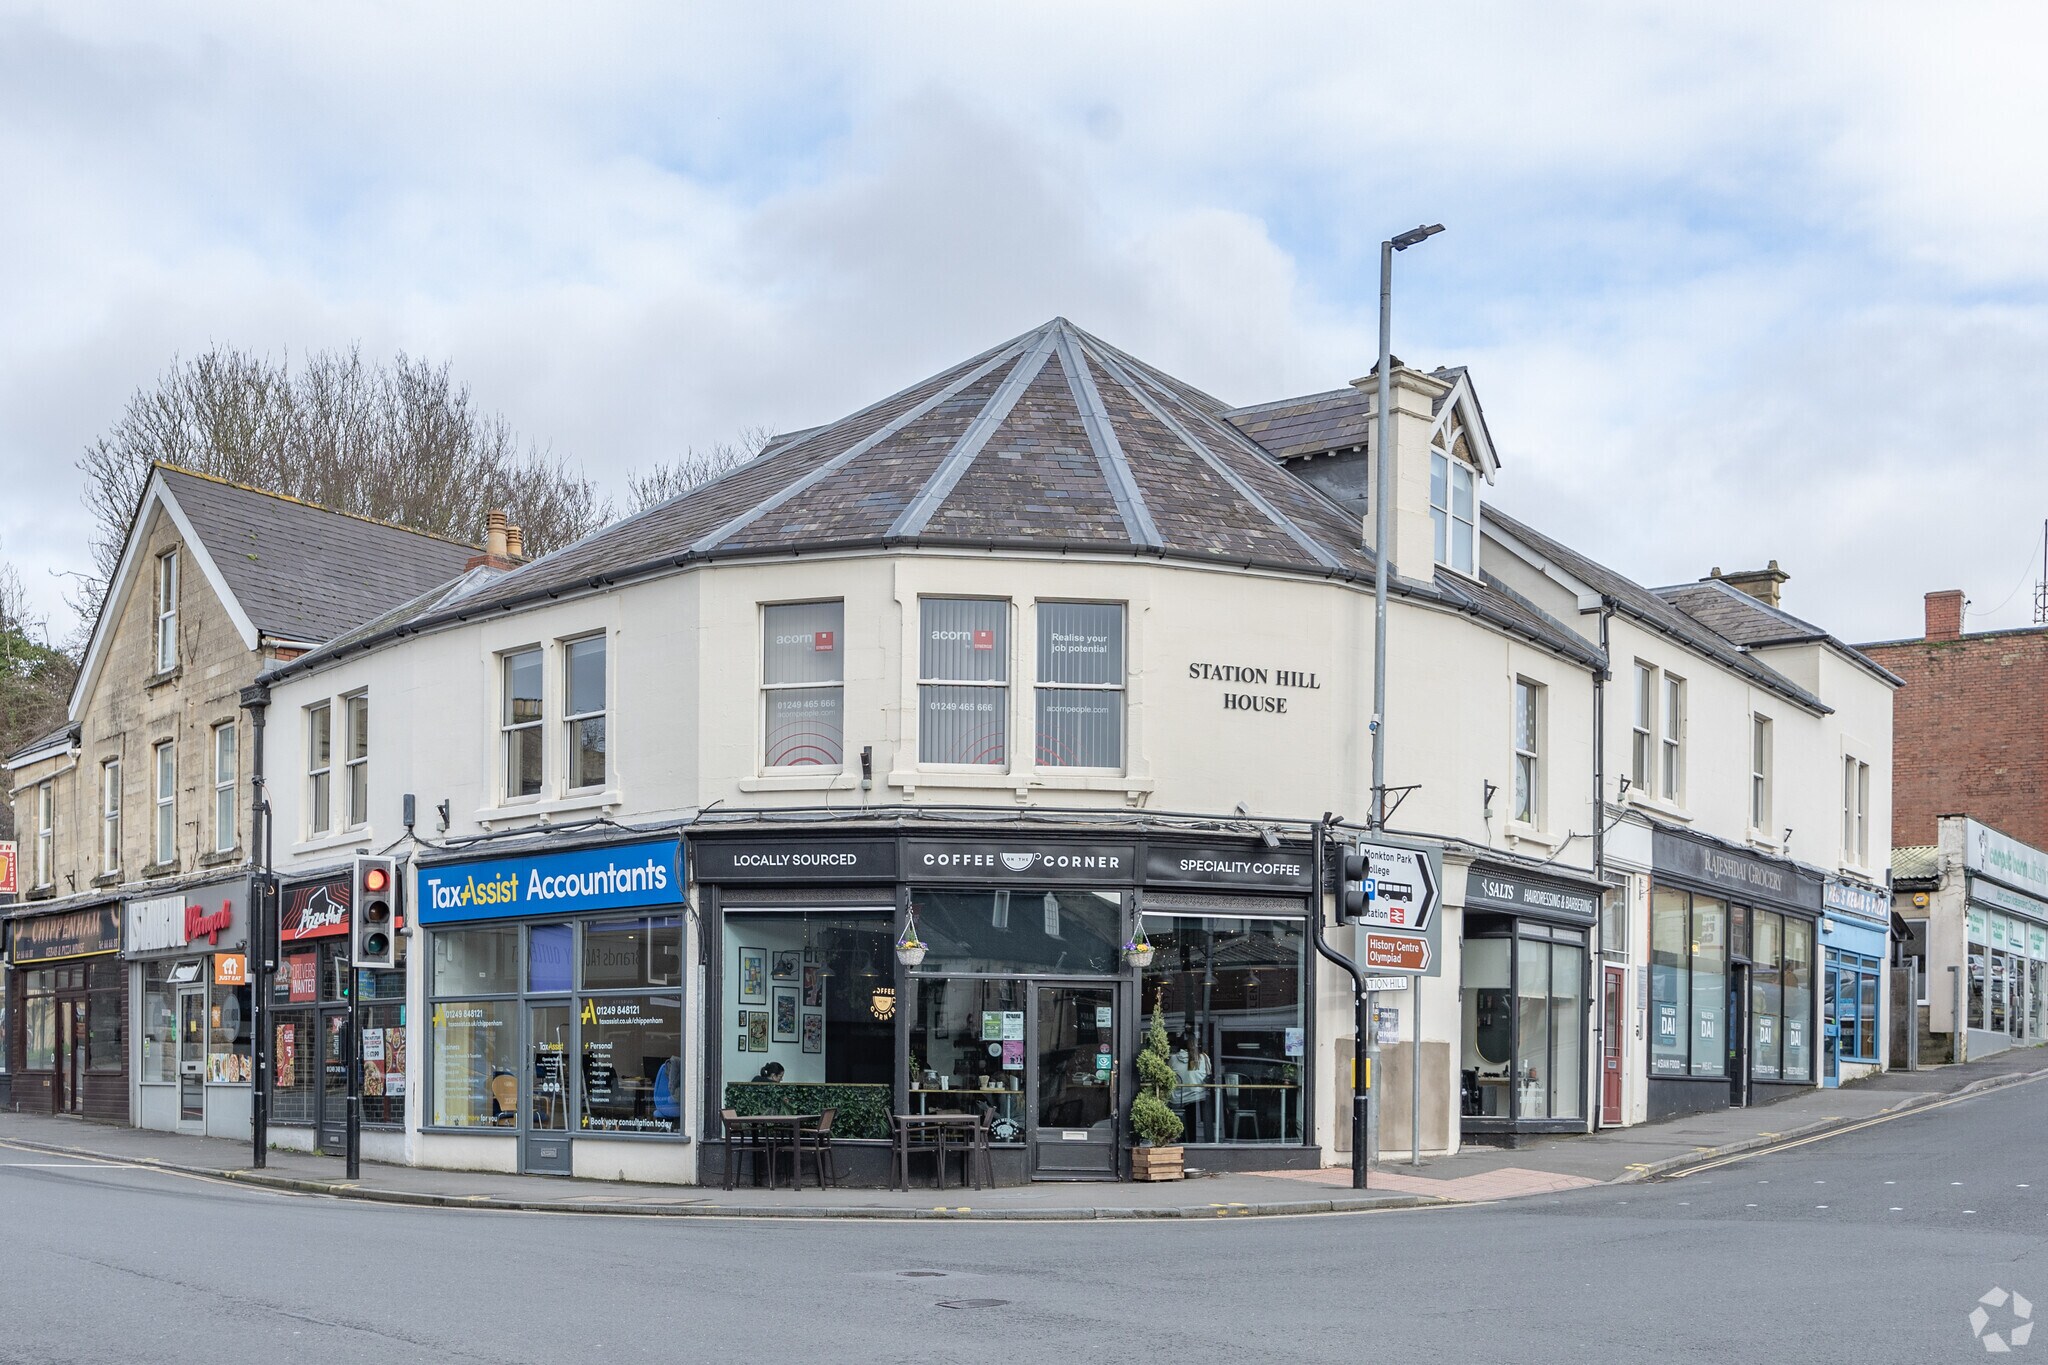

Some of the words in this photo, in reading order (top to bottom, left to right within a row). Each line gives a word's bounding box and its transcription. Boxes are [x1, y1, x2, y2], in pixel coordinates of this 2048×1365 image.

[776, 634, 812, 645] acorn
[932, 630, 971, 641] acorn
[1052, 633, 1085, 642] Realise
[1087, 635, 1108, 643] your
[1052, 643, 1066, 654] job
[1068, 644, 1107, 653] potential
[1189, 662, 1268, 684] STATION
[1276, 670, 1321, 690] HILL
[777, 701, 802, 710] 01249
[803, 700, 819, 709] 465
[820, 699, 836, 708] 666
[930, 702, 957, 711] 01249
[959, 703, 975, 711] 465
[977, 703, 993, 711] 666
[1046, 705, 1109, 714] acornpeople.com
[1223, 693, 1288, 714] HOUSE
[734, 855, 790, 866] LOCALLY
[792, 854, 857, 866] SOURCED
[923, 854, 995, 867] COFFEE
[1043, 856, 1120, 869] CORNER
[1364, 848, 1395, 862] Monkton
[1396, 853, 1413, 864] Park
[1180, 859, 1251, 873] SPECIALITY
[1252, 863, 1300, 876] COFFEE
[1368, 865, 1390, 876] ollege
[1705, 849, 1746, 880] RAJESHDAI
[1748, 863, 1782, 891] GROCERY
[428, 873, 519, 909] TaxAssist
[526, 859, 667, 901] Accountants
[1488, 881, 1514, 900] SALTS
[1523, 888, 1560, 908] HAIRDRESSING
[1561, 895, 1565, 909] &
[1566, 896, 1592, 913] BARBERING
[300, 908, 325, 932] Pizza
[325, 904, 346, 926] Hut
[1367, 910, 1388, 919] tation
[32, 912, 101, 943] CHIPPENHAM
[1369, 939, 1395, 952] History
[1396, 941, 1419, 953] Centre
[1369, 952, 1401, 963] Olympiad
[292, 962, 315, 979] DRIVERS
[292, 979, 316, 994] WANTED
[1366, 979, 1388, 989] ATION
[1389, 979, 1406, 988] HILL
[446, 1010, 462, 1018] 01249
[464, 1010, 483, 1018] 848121
[596, 1006, 616, 1015] 01249
[617, 1005, 640, 1015] 848121
[870, 1006, 896, 1020] CORNER
[1662, 1007, 1675, 1016] RAJESH
[599, 1017, 663, 1025] taxassist.co.uk/chippenham
[1661, 1017, 1675, 1035] DAI
[1701, 1021, 1714, 1038] DAI
[1760, 1027, 1771, 1043] DAI
[1791, 1030, 1801, 1046] DAI
[1670, 1059, 1680, 1069] FOOD
[480, 1114, 488, 1122] for
[591, 1117, 604, 1125] Book
[604, 1119, 618, 1127] your
[619, 1118, 654, 1127] consultation
[655, 1119, 672, 1129] today
